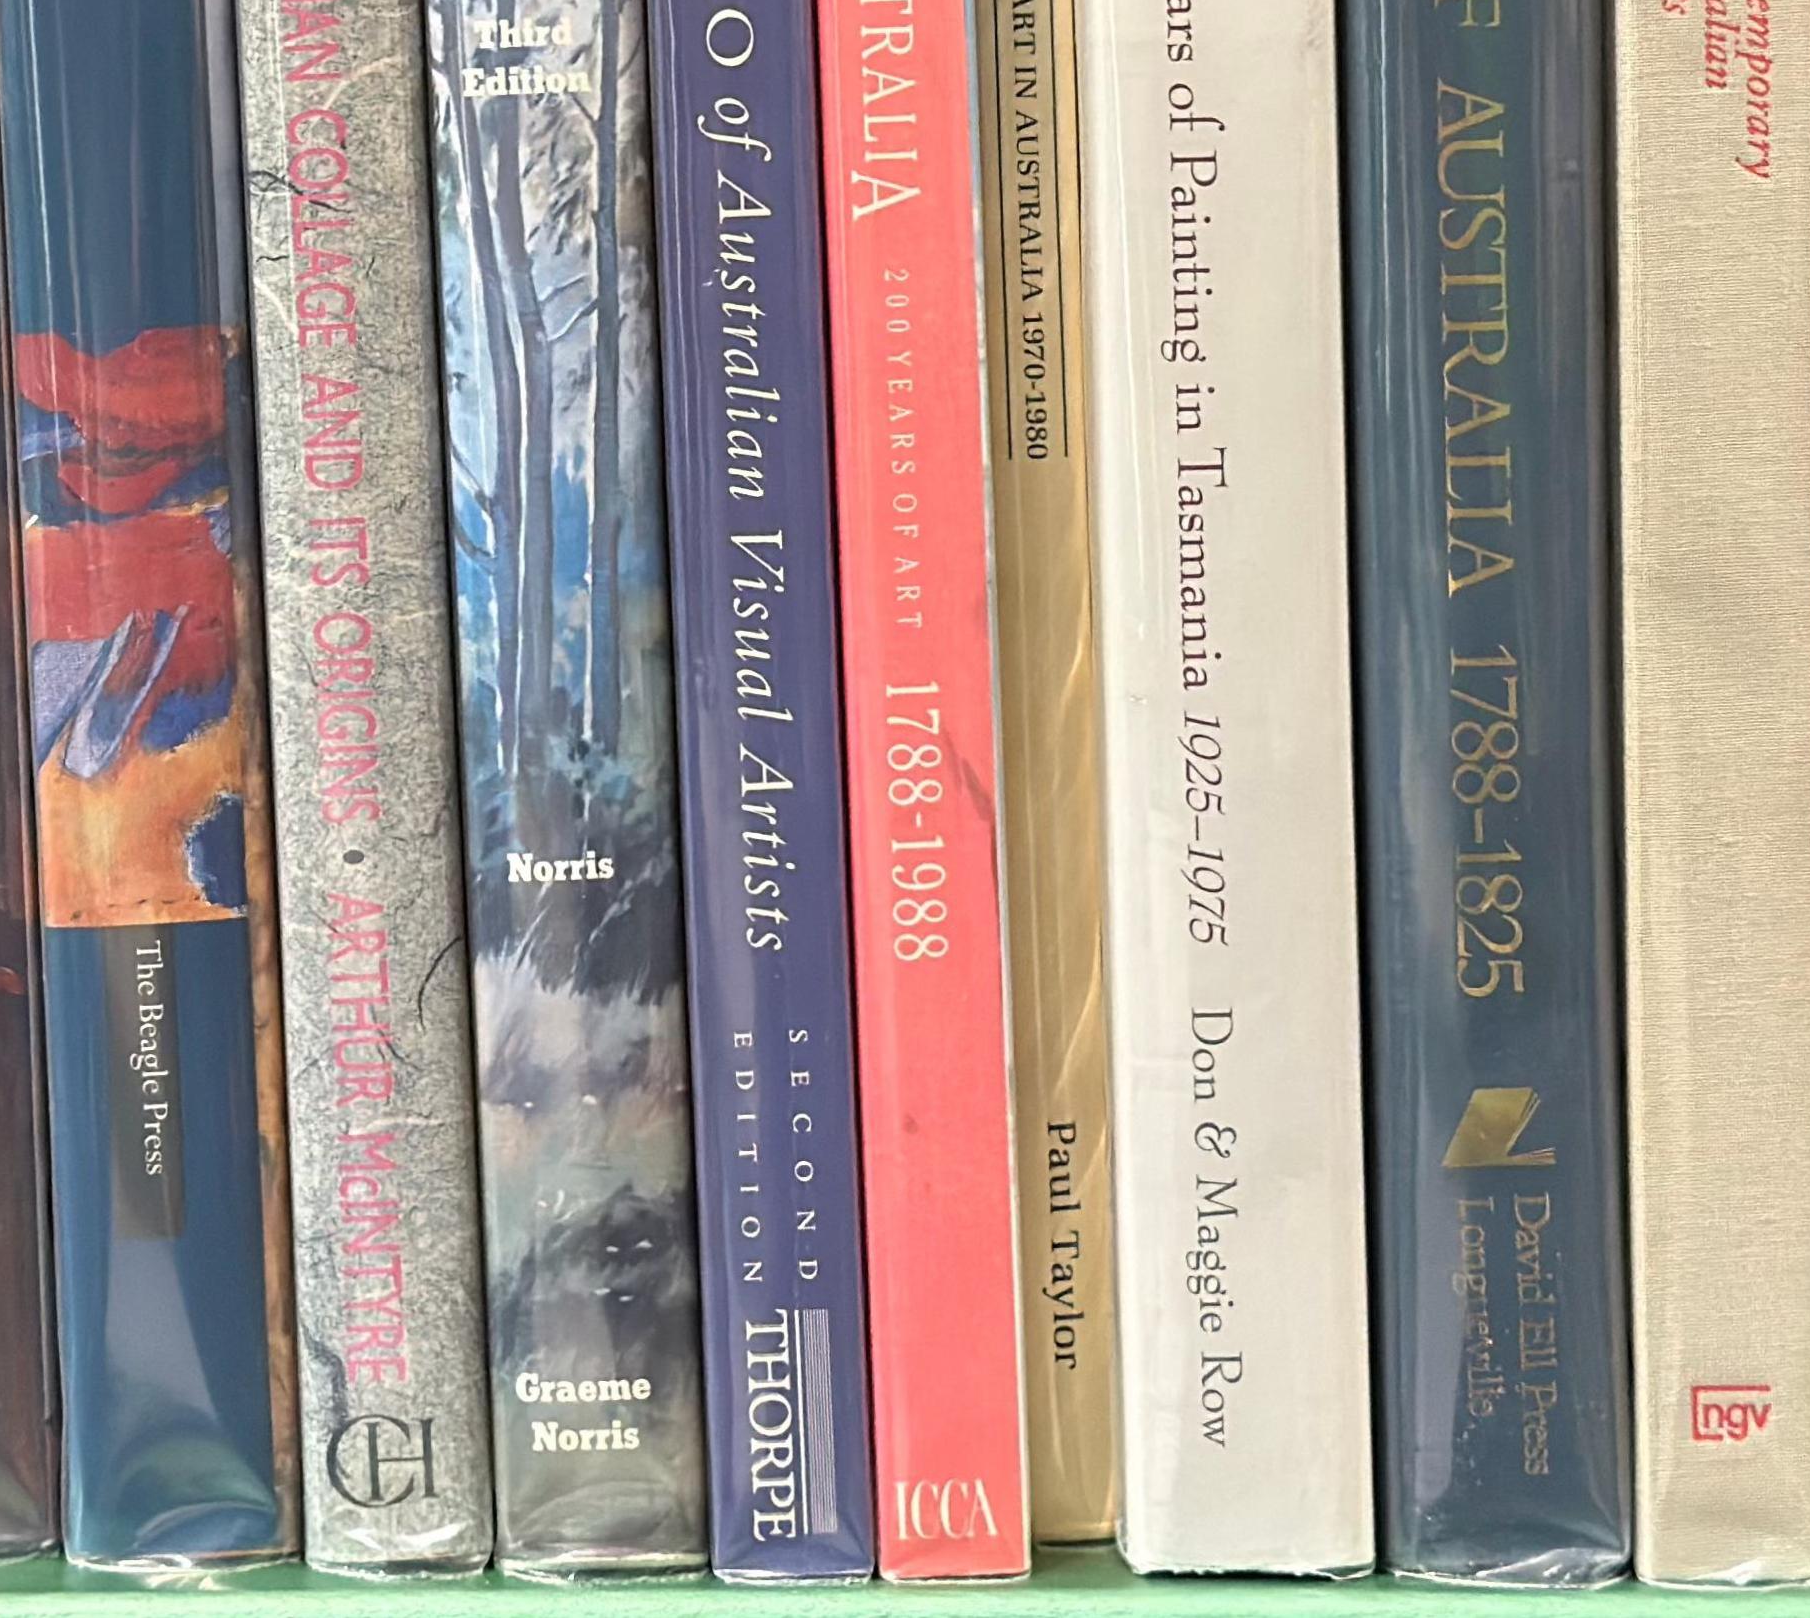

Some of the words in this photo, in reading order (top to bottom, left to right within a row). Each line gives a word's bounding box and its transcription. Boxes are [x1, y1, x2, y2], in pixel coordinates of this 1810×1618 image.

[461, 67, 590, 97] Edition
[473, 18, 572, 47] Third
[1014, 62, 1037, 99] IN
[698, 98, 771, 162] of
[1167, 84, 1225, 132] of
[283, 108, 357, 349] COLLAGE
[1015, 109, 1042, 302] AUSTRALIA
[1161, 150, 1216, 363] Painting
[717, 171, 780, 500] Australian
[1022, 313, 1048, 460] 1970-1980
[1438, 79, 1515, 599] AUSTRALIA
[301, 371, 364, 491] AND
[1175, 383, 1216, 432] in
[306, 515, 367, 588] ITS
[1177, 446, 1227, 691] Tasmania
[731, 529, 792, 723] Visual
[312, 611, 381, 825] ORIGINS
[506, 853, 614, 879] Norris
[738, 743, 796, 952] Artists
[885, 681, 949, 962] 1788-1988
[1449, 643, 1525, 1000] 1788-1825
[136, 939, 164, 996] The
[129, 1003, 169, 1095] Beagle
[1190, 1007, 1233, 1102] Don
[143, 1101, 169, 1176] Press
[1047, 1120, 1078, 1213] Paul
[1050, 1229, 1084, 1370] Taylor
[1187, 1177, 1239, 1335] Maggie
[1514, 1192, 1551, 1305] David
[515, 1374, 650, 1402] Graeme
[532, 1422, 640, 1450] Norris
[744, 1309, 795, 1541] THORPE
[1200, 1350, 1242, 1448] Row
[895, 1480, 997, 1540] ICCA
